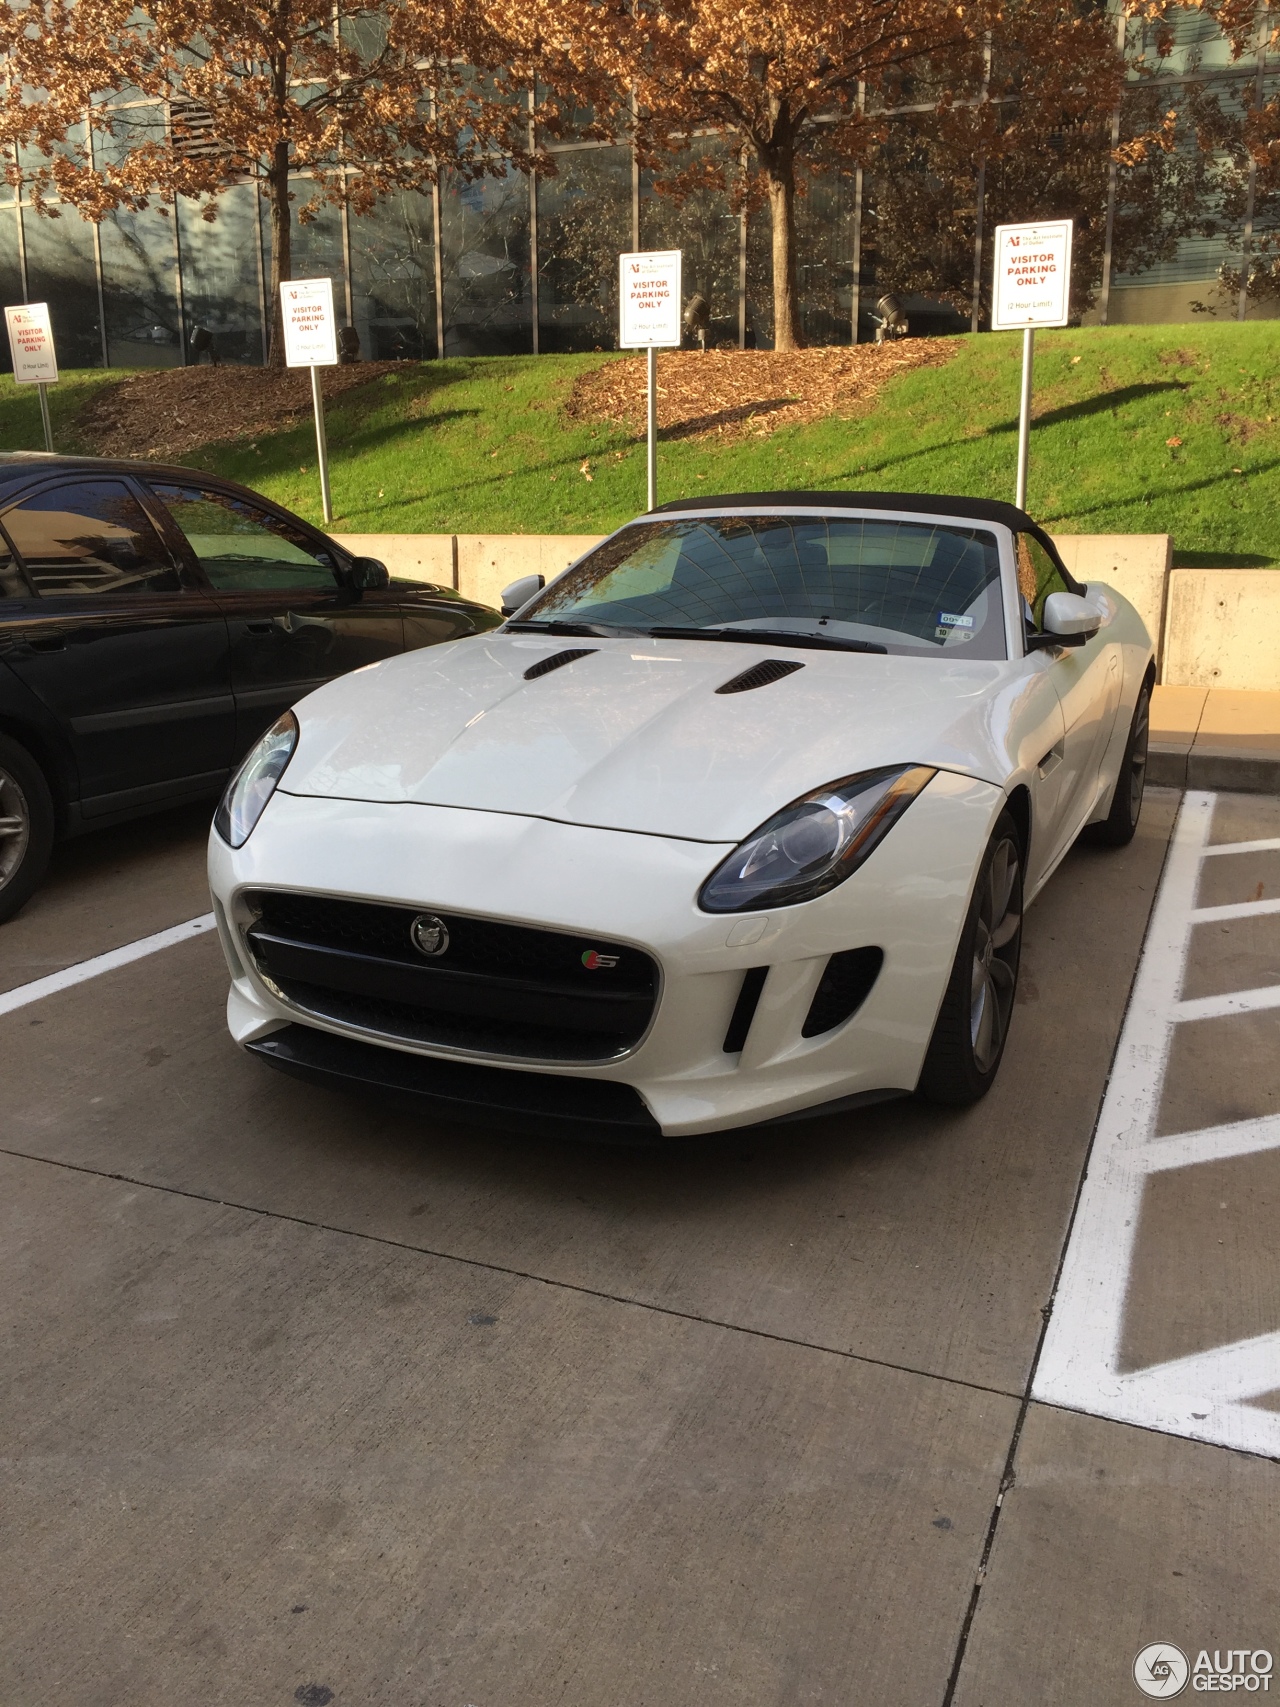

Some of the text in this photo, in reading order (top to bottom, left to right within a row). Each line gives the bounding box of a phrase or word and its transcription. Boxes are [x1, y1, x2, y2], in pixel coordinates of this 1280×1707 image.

[1011, 253, 1054, 264] VISITOR
[1007, 264, 1057, 275] PARKING
[633, 280, 668, 289] VISITOR
[1017, 276, 1046, 286] ONLY
[630, 290, 670, 299] PARKING
[293, 305, 322, 313] VISITOR
[638, 301, 662, 309] ONLY
[291, 314, 325, 323] PARKING
[17, 328, 43, 336] VISITOR
[17, 336, 46, 344] PARKING
